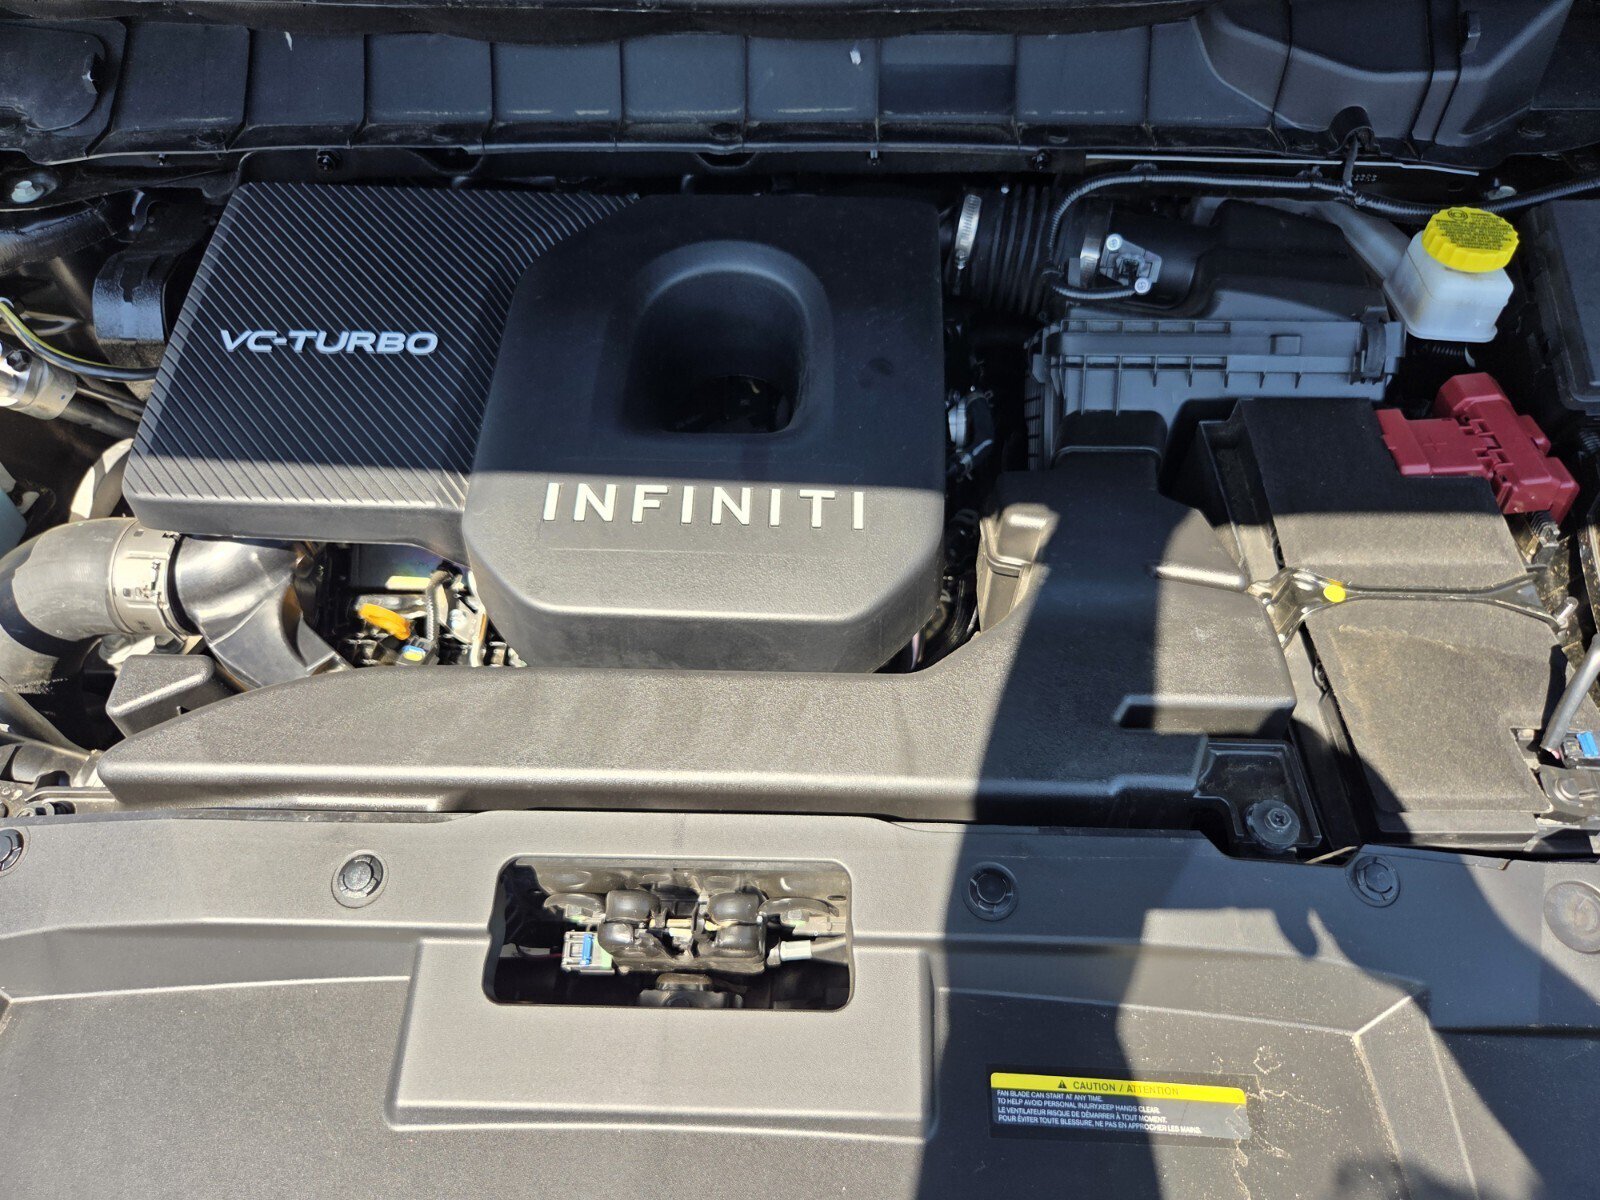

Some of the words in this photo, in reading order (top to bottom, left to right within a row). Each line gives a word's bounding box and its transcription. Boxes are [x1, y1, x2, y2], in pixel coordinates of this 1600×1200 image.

[220, 329, 439, 355] VC-TURBO
[543, 482, 865, 530] INFINITI
[1010, 1090, 1030, 1098] BLADE
[1046, 1092, 1064, 1100] START
[1073, 1081, 1116, 1091] CAUTION
[1126, 1084, 1179, 1095] ATTENTION
[1024, 1099, 1043, 1107] AVOID
[1044, 1100, 1077, 1108] PERSONAL
[1115, 1104, 1137, 1112] HANDS
[1006, 1107, 1046, 1115] VENTILATEUR
[1047, 1109, 1070, 1117] RISQUE
[1081, 1110, 1115, 1119] DÉMARRER
[1121, 1113, 1137, 1121] TOUT
[998, 1114, 1016, 1122] POUR
[1017, 1114, 1039, 1123] ÉVITER
[1128, 1123, 1167, 1132] APPROCHER
[1167, 1124, 1180, 1133] LES
